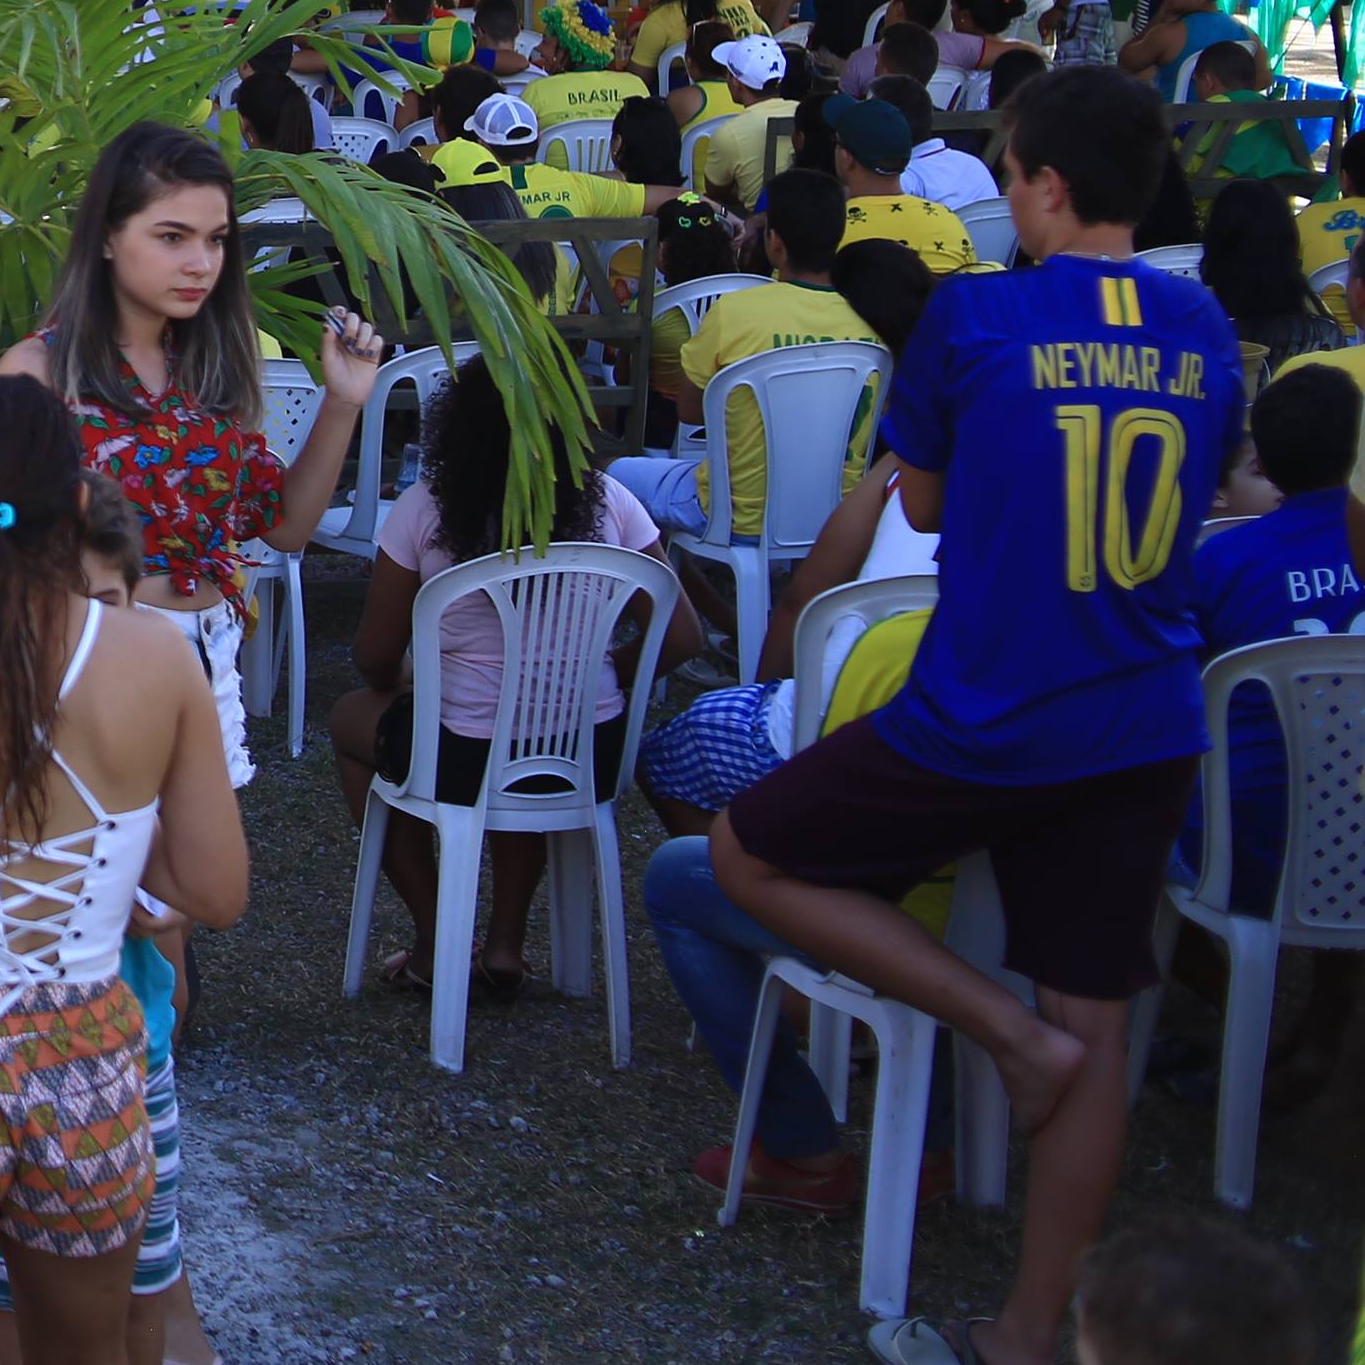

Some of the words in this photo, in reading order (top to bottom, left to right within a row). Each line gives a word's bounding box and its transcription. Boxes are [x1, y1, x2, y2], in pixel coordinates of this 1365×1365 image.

[567, 89, 622, 105] BRASIL
[1031, 342, 1161, 393] NEYMAR
[1167, 351, 1206, 400] JR.
[1055, 404, 1186, 592] 10
[1287, 563, 1362, 603] BRA
